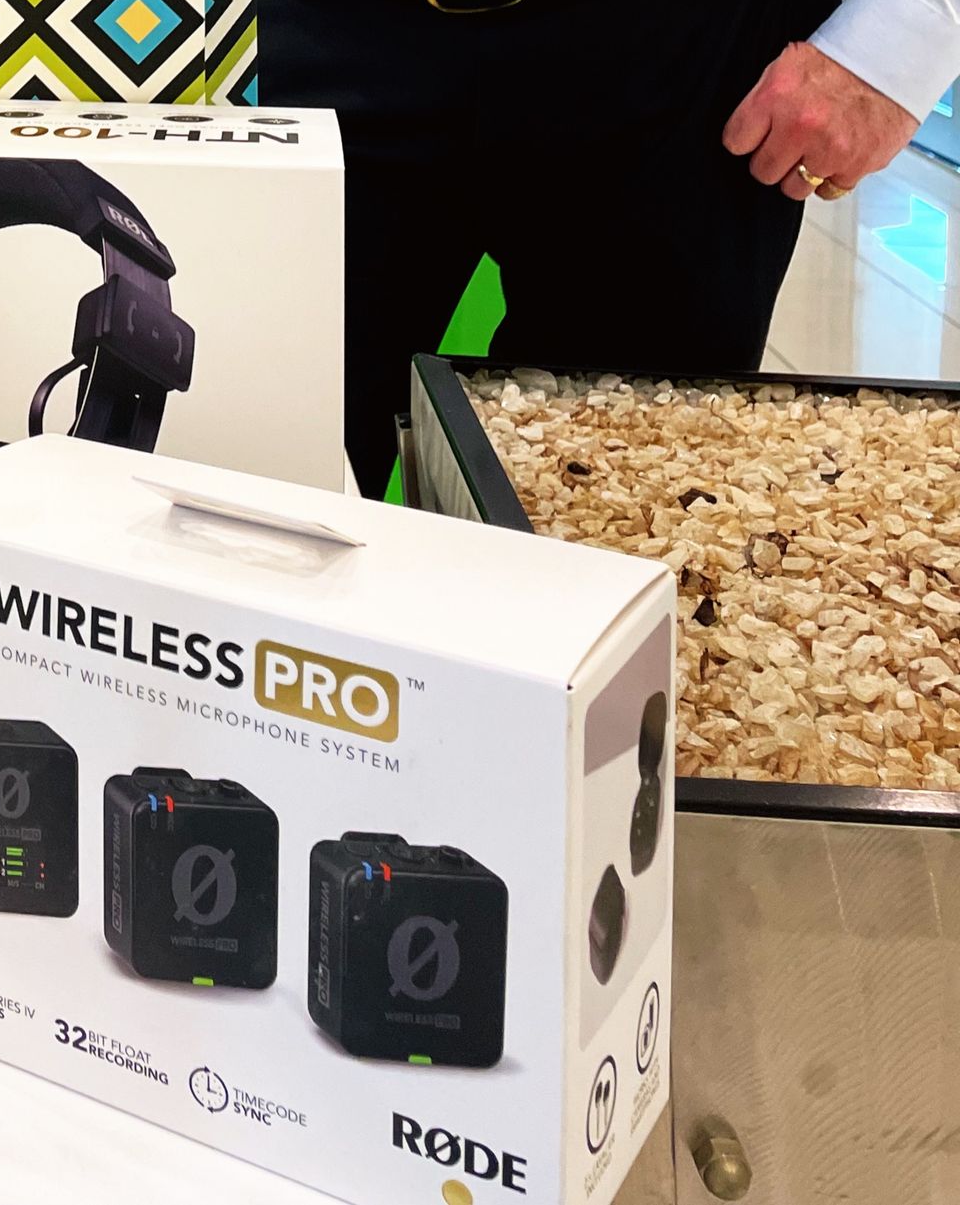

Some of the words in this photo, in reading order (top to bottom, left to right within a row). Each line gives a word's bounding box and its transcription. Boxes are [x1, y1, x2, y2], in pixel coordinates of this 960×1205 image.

[10, 125, 299, 144] NTH-100
[264, 650, 391, 728] PRO
[80, 668, 168, 707] WIRELESS
[177, 697, 311, 749] MICROPHONE
[321, 737, 401, 774] SYSTEM
[24, 1005, 36, 1019] IV
[54, 1018, 88, 1053] 32
[88, 1030, 106, 1048] BIT
[111, 1039, 152, 1064] FLOAT
[89, 1045, 169, 1086] RECORDING
[233, 1087, 308, 1127] TIMECODE
[233, 1102, 272, 1126] SYNC
[392, 1111, 528, 1195] RØDE
